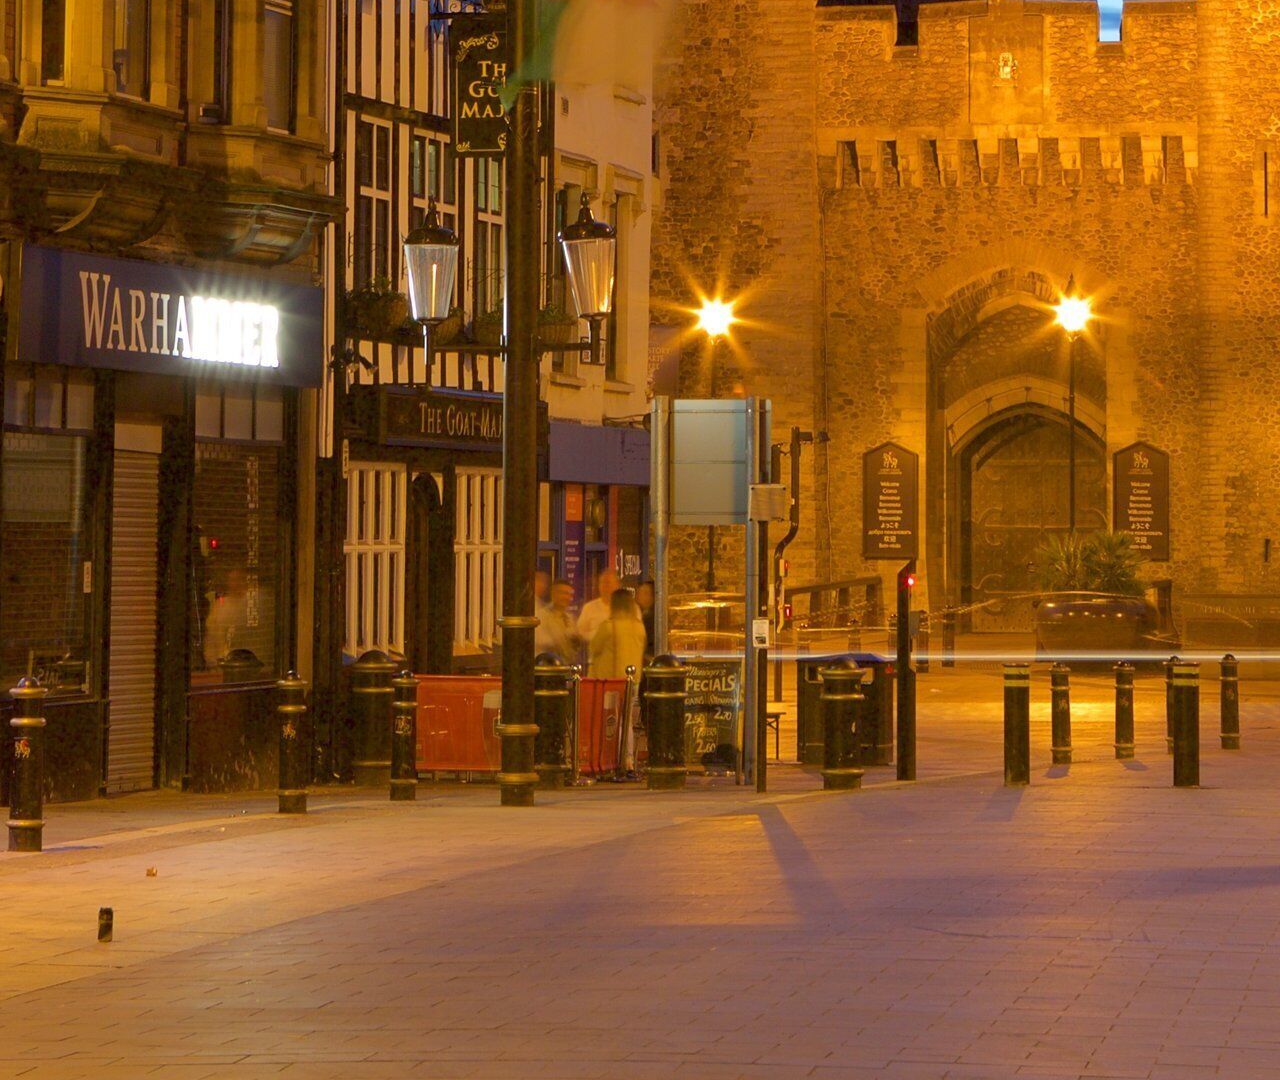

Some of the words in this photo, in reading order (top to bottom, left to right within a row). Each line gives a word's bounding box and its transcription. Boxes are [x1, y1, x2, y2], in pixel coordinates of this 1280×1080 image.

[477, 60, 507, 78] TH
[461, 101, 505, 119] MAJ
[79, 271, 280, 368] WARHAER
[419, 401, 442, 433] THE
[447, 404, 477, 436] GOAT
[480, 407, 503, 440] MAJ
[685, 674, 736, 692] PECIALS
